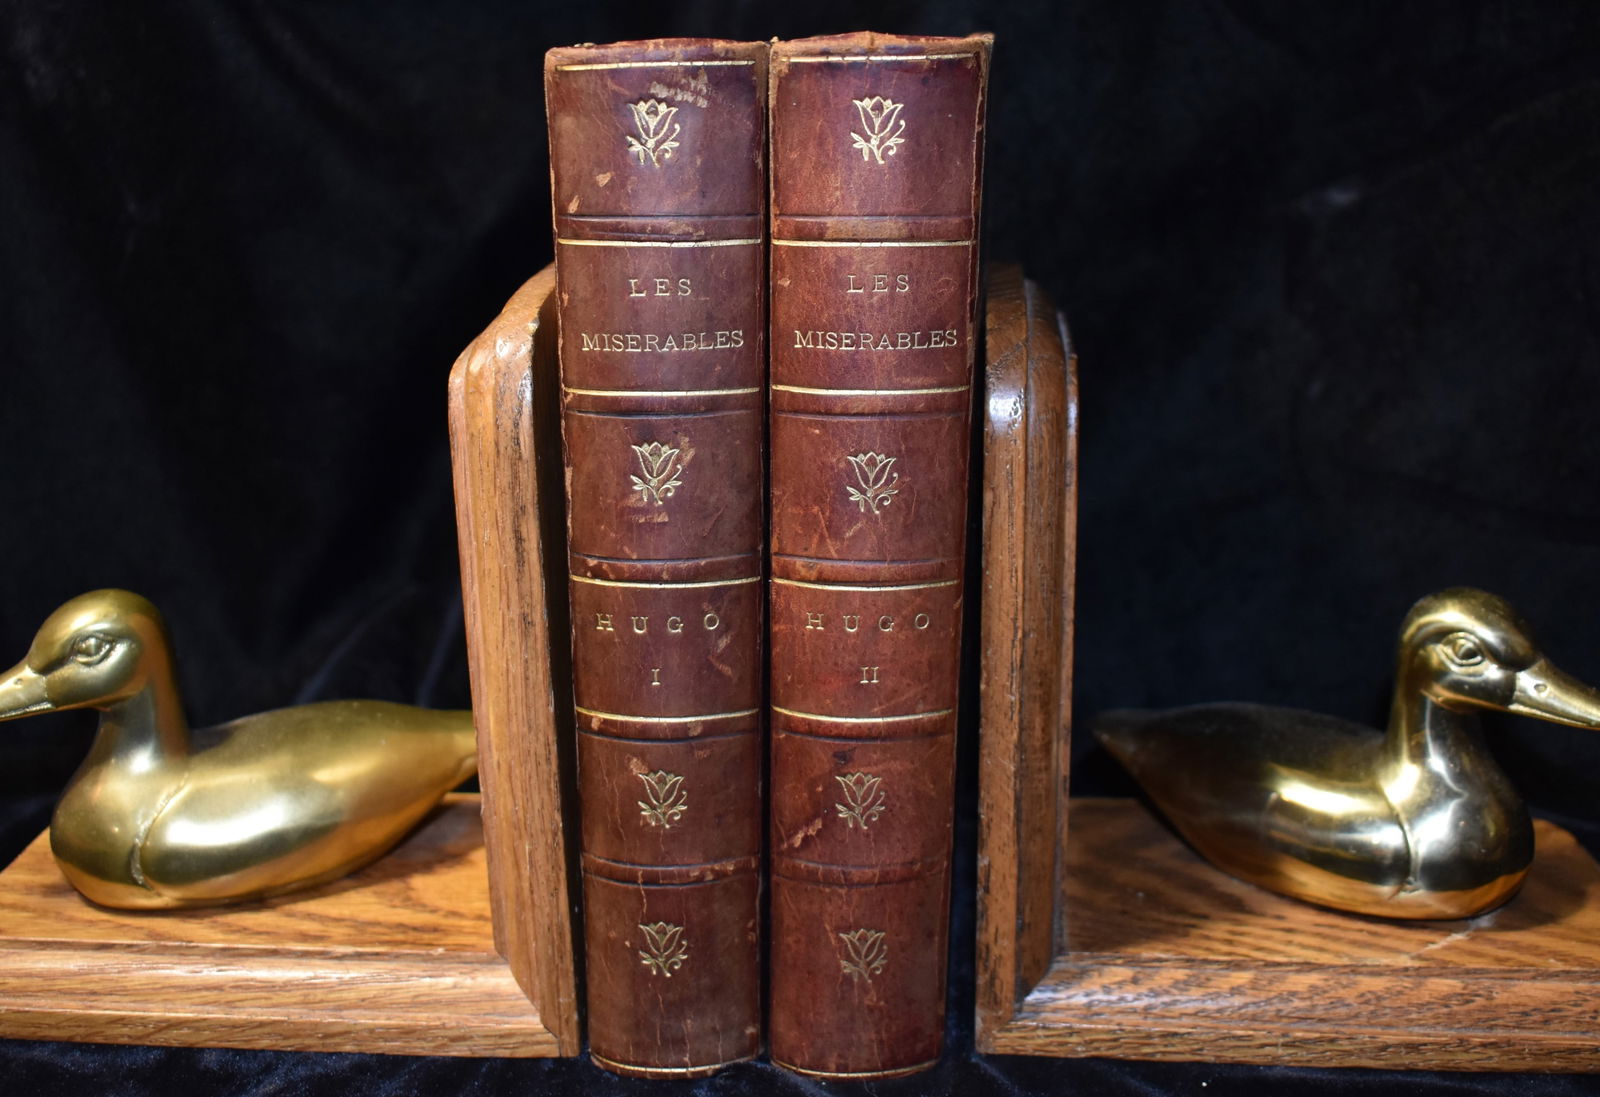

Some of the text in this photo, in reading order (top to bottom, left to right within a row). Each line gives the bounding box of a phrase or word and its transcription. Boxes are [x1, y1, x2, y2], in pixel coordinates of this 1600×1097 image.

[628, 277, 693, 299] LES
[846, 273, 911, 295] LES
[580, 329, 746, 354] MISERABLES
[793, 328, 959, 352] MISERABLES
[595, 611, 722, 636] HUGO
[804, 610, 932, 635] HUGO
[650, 667, 662, 688] I
[859, 665, 881, 685] II
